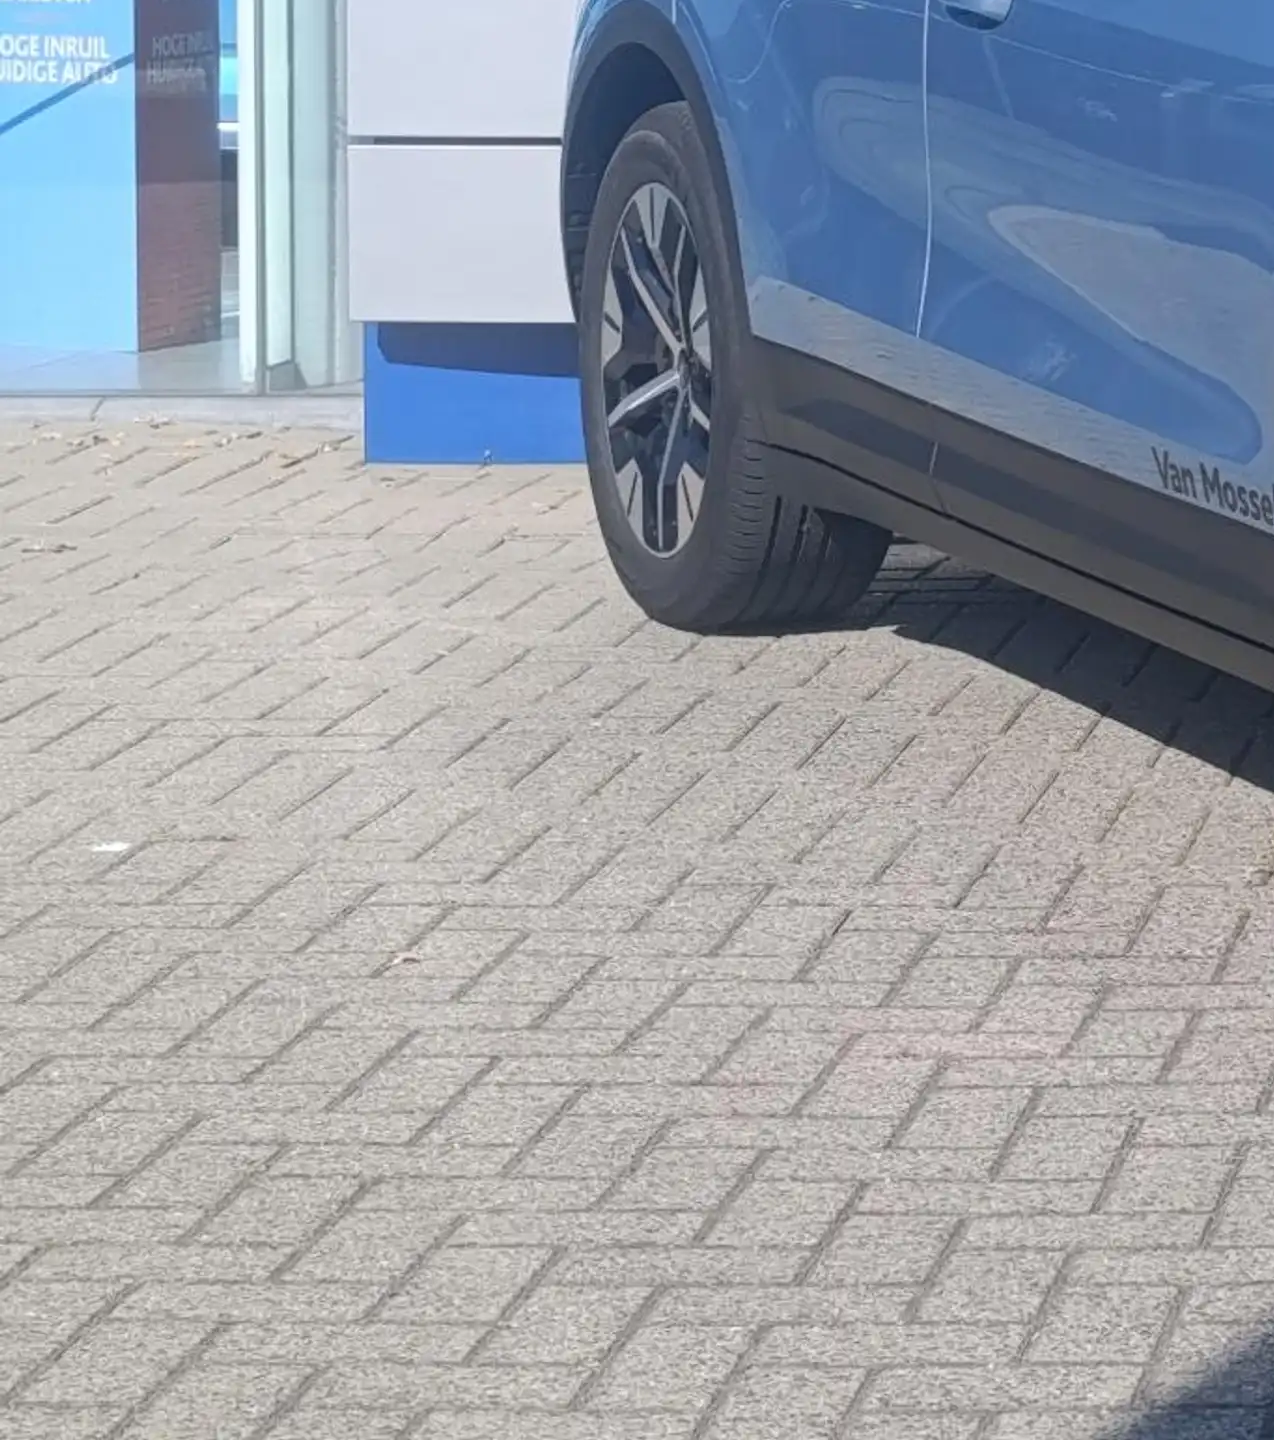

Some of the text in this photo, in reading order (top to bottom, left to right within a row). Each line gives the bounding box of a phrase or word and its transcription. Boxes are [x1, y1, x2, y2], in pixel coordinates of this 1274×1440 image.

[0, 34, 111, 59] OGE INRUIL
[0, 60, 58, 83] IDIGE
[1151, 445, 1198, 498] Van
